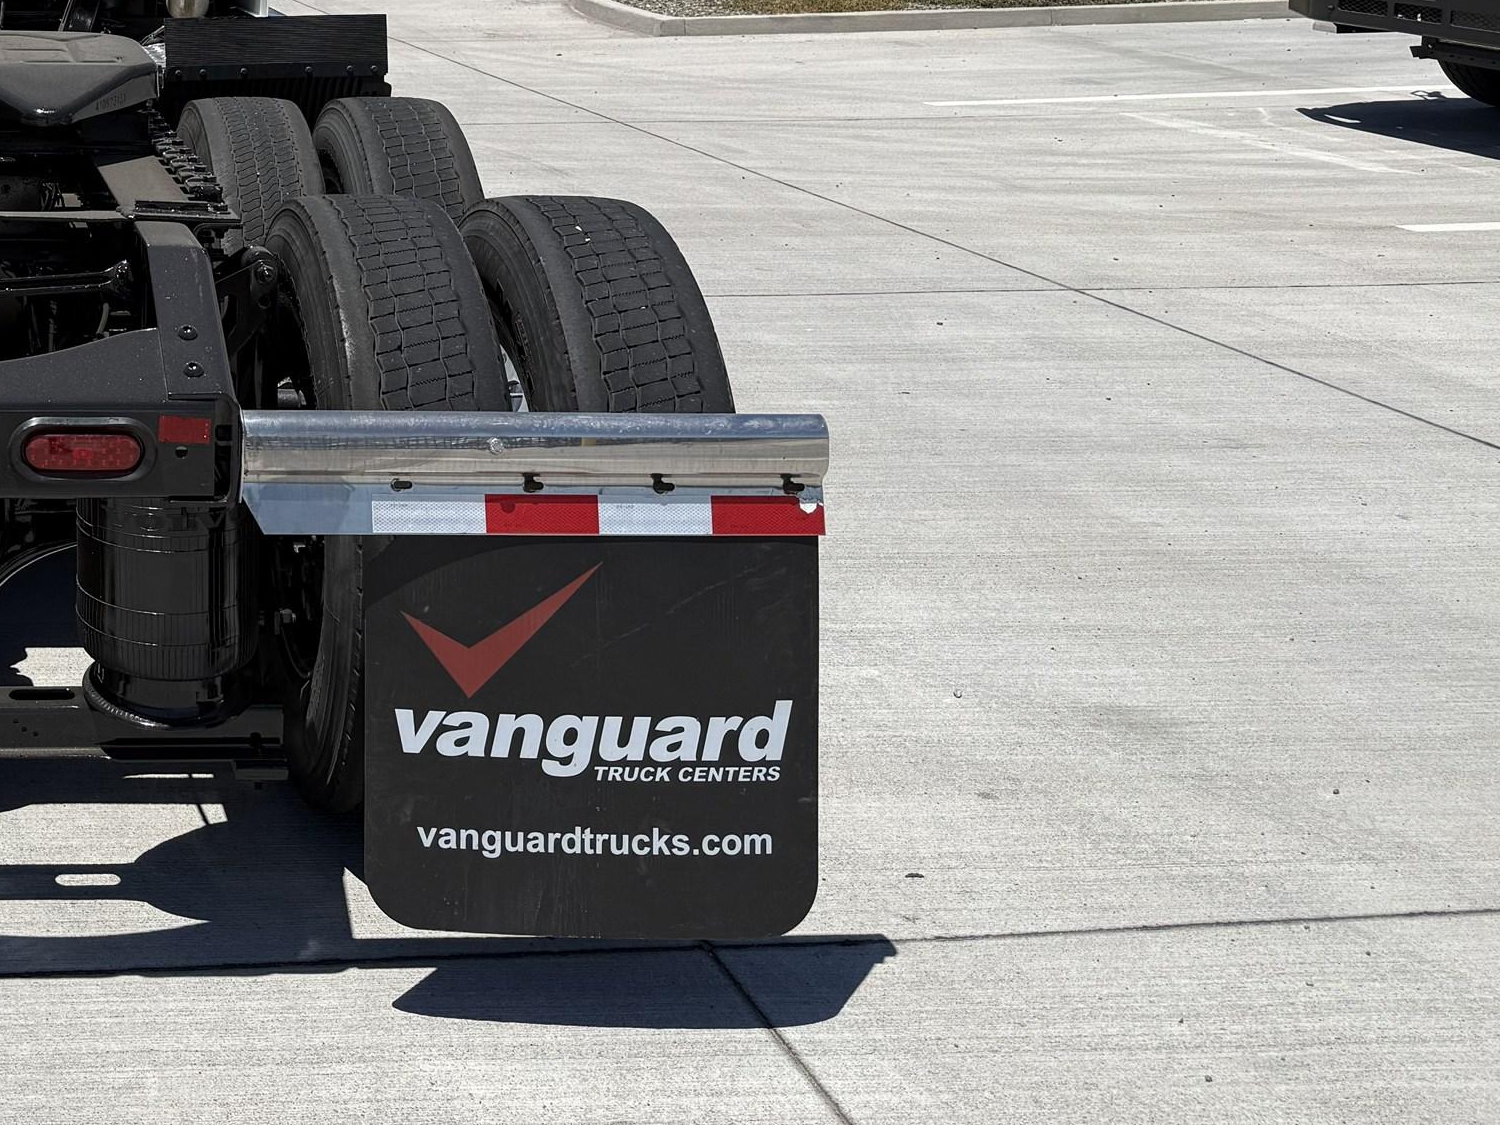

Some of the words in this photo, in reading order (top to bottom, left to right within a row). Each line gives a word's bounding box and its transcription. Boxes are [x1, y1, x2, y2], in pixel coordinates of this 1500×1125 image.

[394, 699, 793, 778] vanguard
[594, 766, 671, 782] TRUCK
[678, 766, 781, 782] CENTERS
[416, 826, 773, 859] vanguardtrucks.com
